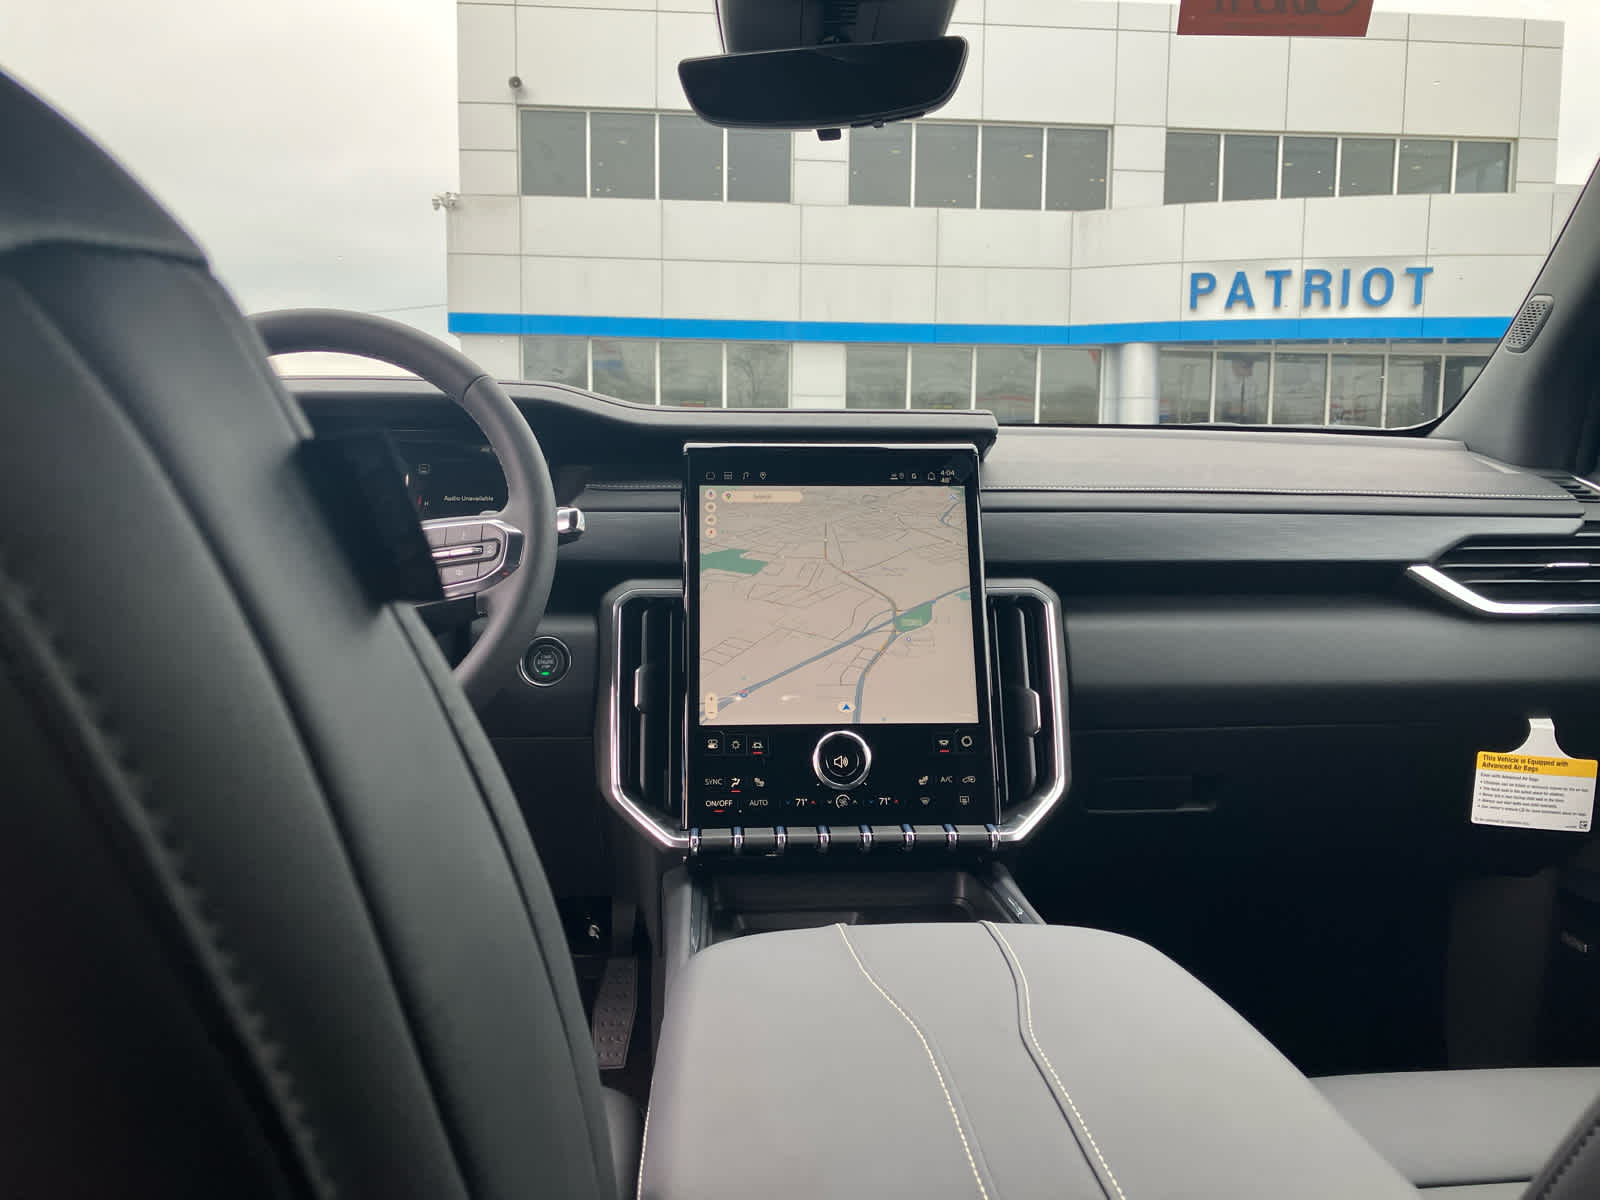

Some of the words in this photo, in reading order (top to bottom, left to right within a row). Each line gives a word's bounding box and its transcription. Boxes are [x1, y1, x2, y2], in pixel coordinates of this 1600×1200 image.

[1190, 266, 1433, 310] PATRIOT
[1483, 754, 1496, 762] This
[1497, 755, 1519, 764] Vehicle
[1527, 758, 1555, 767] Equipped
[1482, 762, 1512, 770] Advanced
[704, 778, 723, 786] SYNC
[940, 775, 953, 784] A/C
[705, 799, 733, 807] ON/OFF
[749, 799, 769, 807] AUTO
